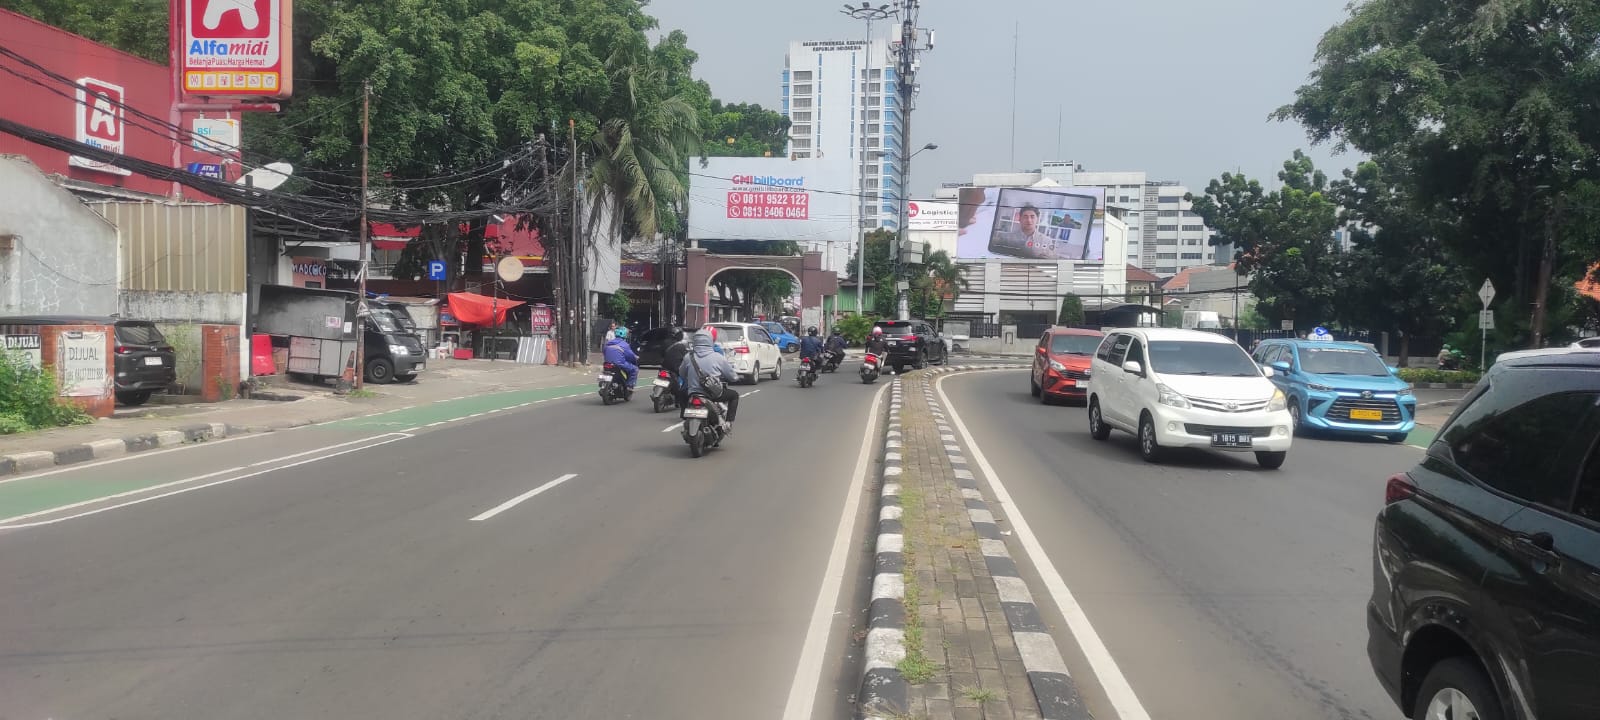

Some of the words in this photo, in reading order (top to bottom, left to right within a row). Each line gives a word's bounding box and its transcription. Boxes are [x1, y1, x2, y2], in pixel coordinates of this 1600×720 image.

[190, 40, 269, 56] Alfamidi
[246, 58, 265, 66] Hemat
[743, 194, 764, 204] 0811
[766, 194, 788, 204] 9522
[791, 194, 806, 205] 122
[432, 262, 444, 276] P
[8, 336, 40, 348] DIJUAL
[68, 348, 98, 360] DIJUAL
